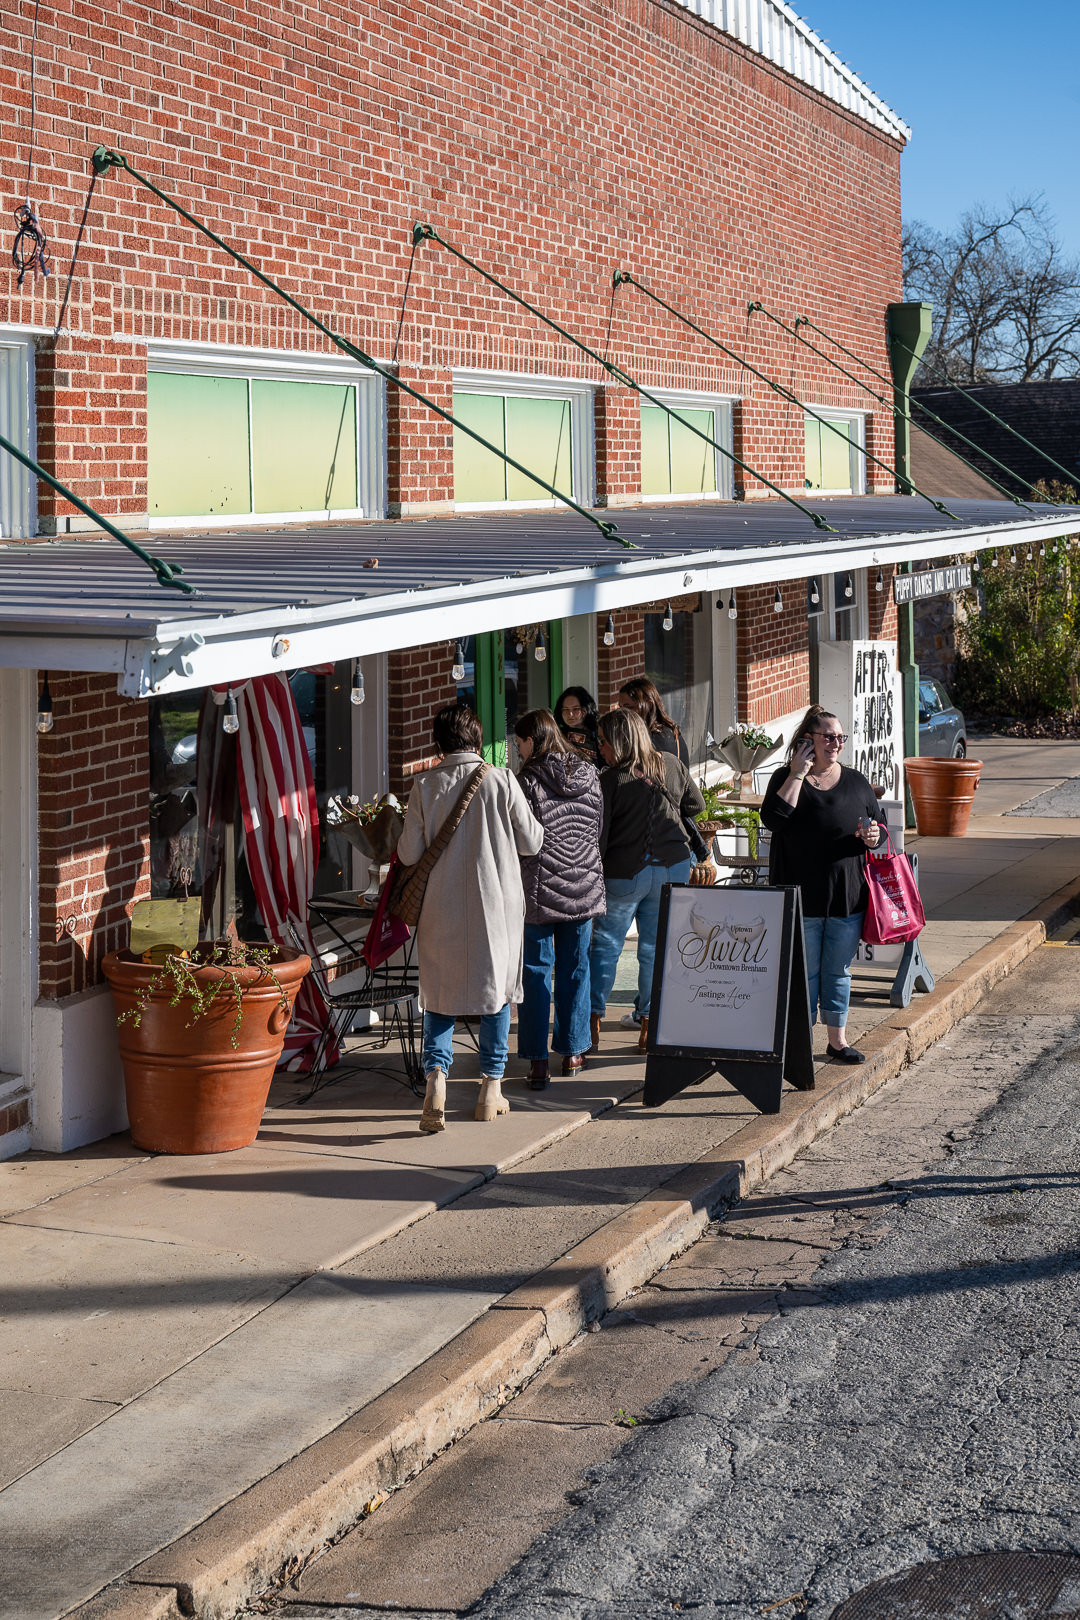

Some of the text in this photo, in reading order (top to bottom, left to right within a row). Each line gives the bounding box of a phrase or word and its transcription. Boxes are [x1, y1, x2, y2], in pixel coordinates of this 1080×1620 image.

[896, 577, 913, 600] PUPPY
[946, 569, 956, 589] CAT
[854, 650, 887, 698] AFTER
[863, 689, 894, 745] HOURS
[730, 925, 753, 933] Uptown
[677, 924, 768, 973] Swirl
[709, 962, 768, 973] Downtown Brenham
[687, 984, 751, 1009] Tastings Here
